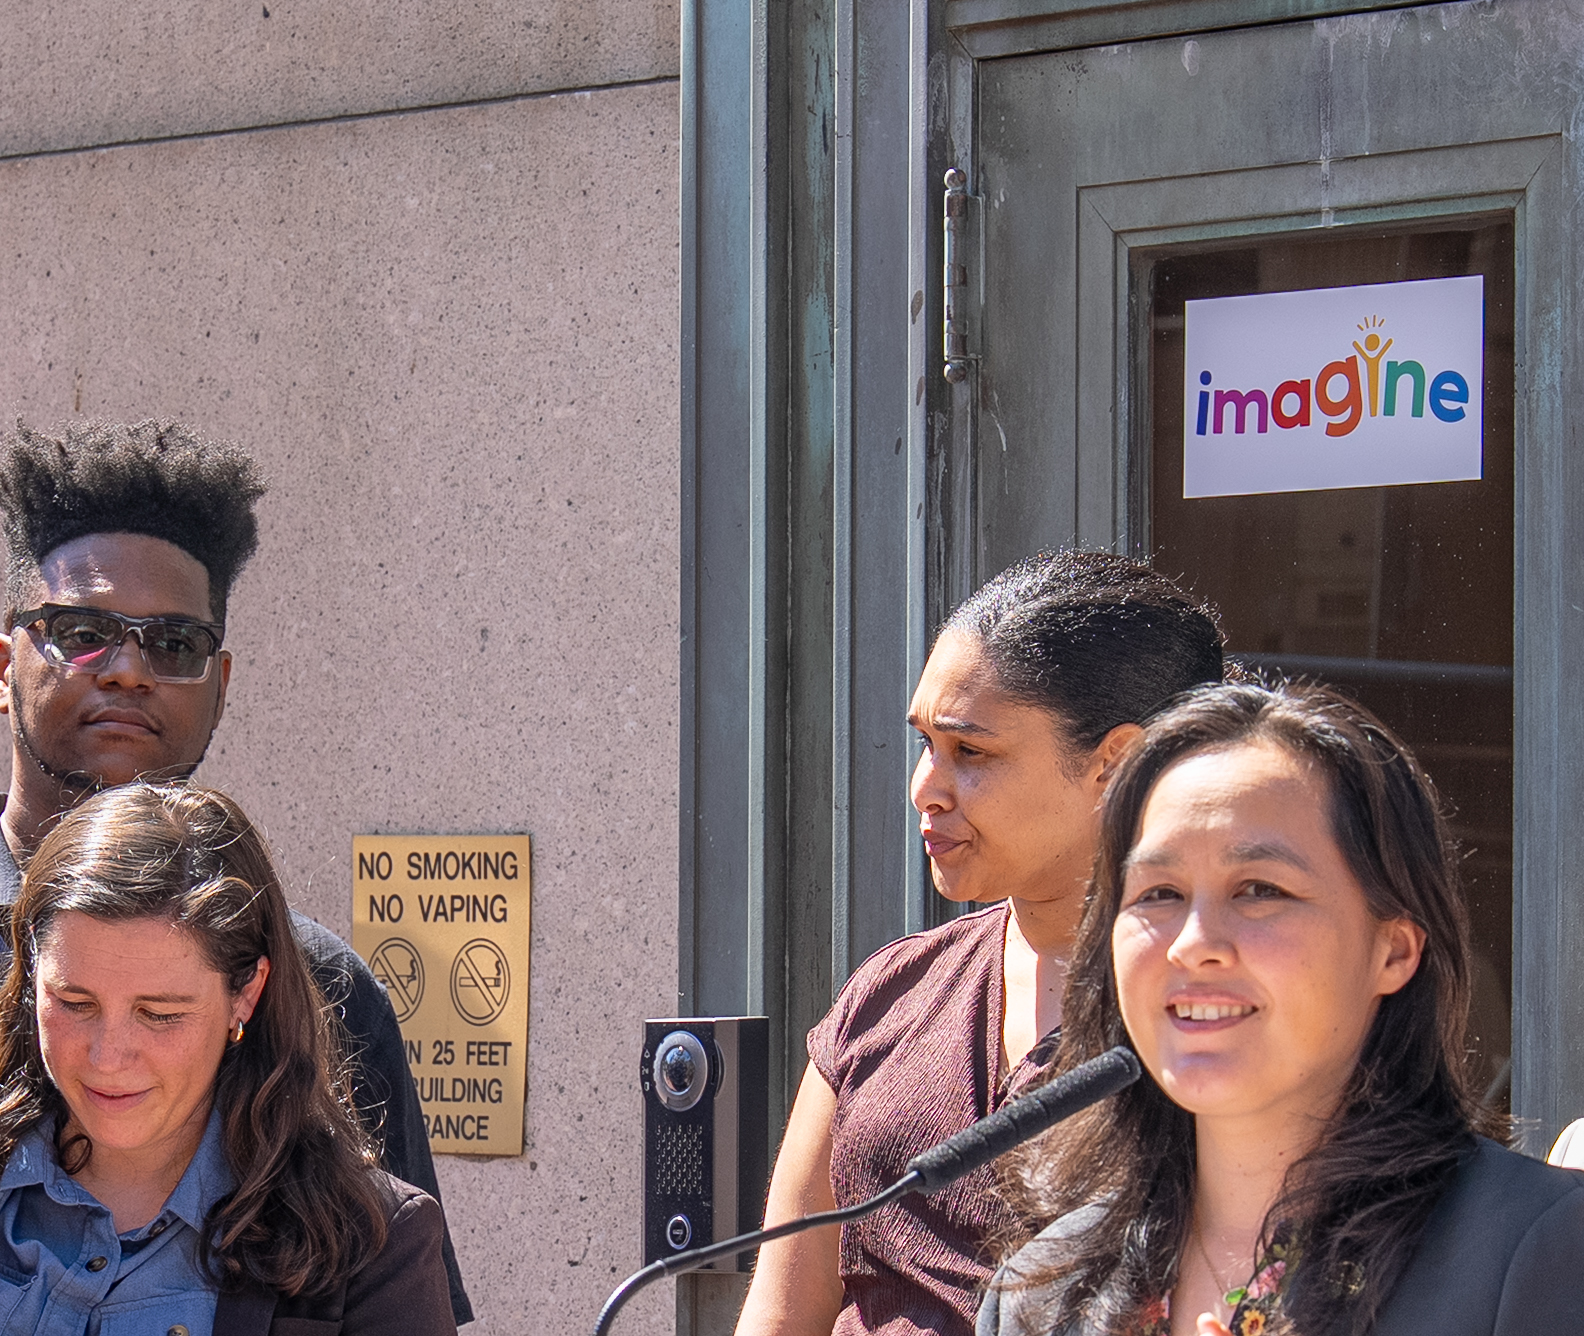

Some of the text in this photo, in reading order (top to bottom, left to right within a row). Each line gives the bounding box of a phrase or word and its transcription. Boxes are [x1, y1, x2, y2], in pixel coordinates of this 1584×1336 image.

[1196, 322, 1469, 437] imagine
[358, 852, 518, 880] NO SMOKING
[369, 894, 507, 922] NO VAPING
[432, 1040, 455, 1065] 25
[466, 1041, 512, 1066] FEET
